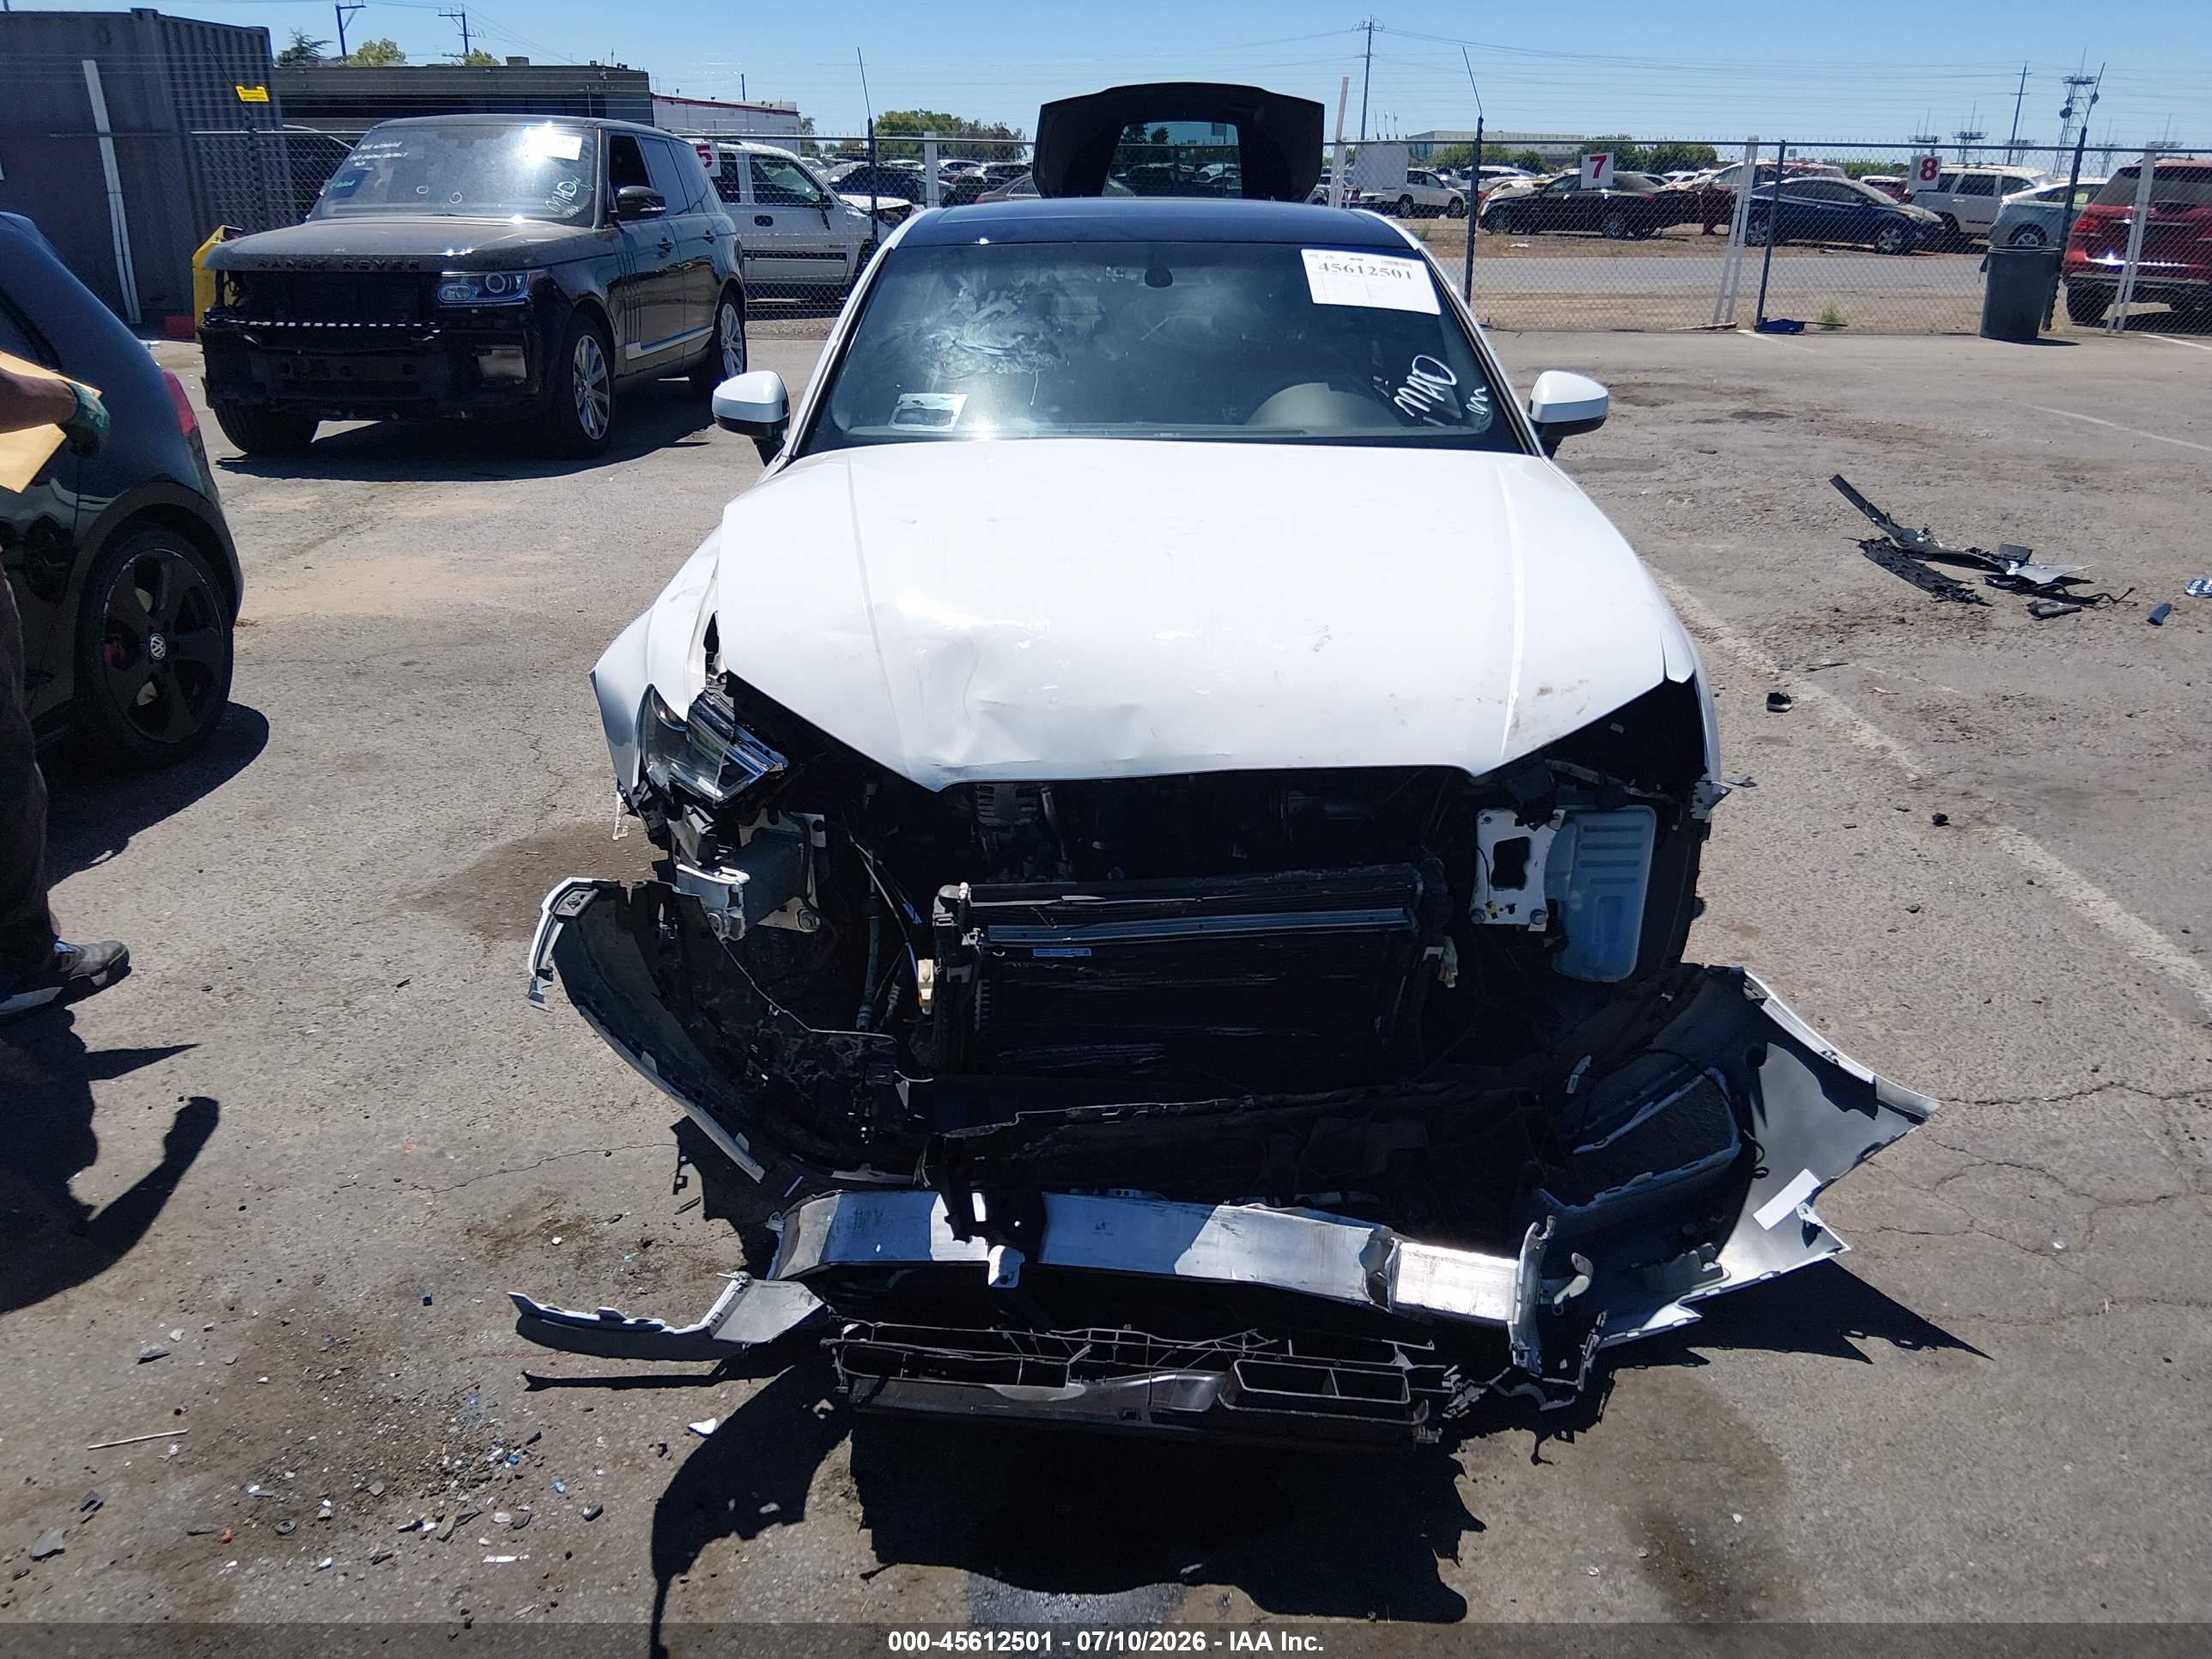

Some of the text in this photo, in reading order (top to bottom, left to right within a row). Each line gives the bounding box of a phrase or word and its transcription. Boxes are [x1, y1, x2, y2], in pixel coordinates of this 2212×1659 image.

[695, 144, 713, 169] 5
[1589, 155, 1607, 179] 7
[1919, 157, 1938, 181] 8
[1318, 261, 1413, 281] 45612501
